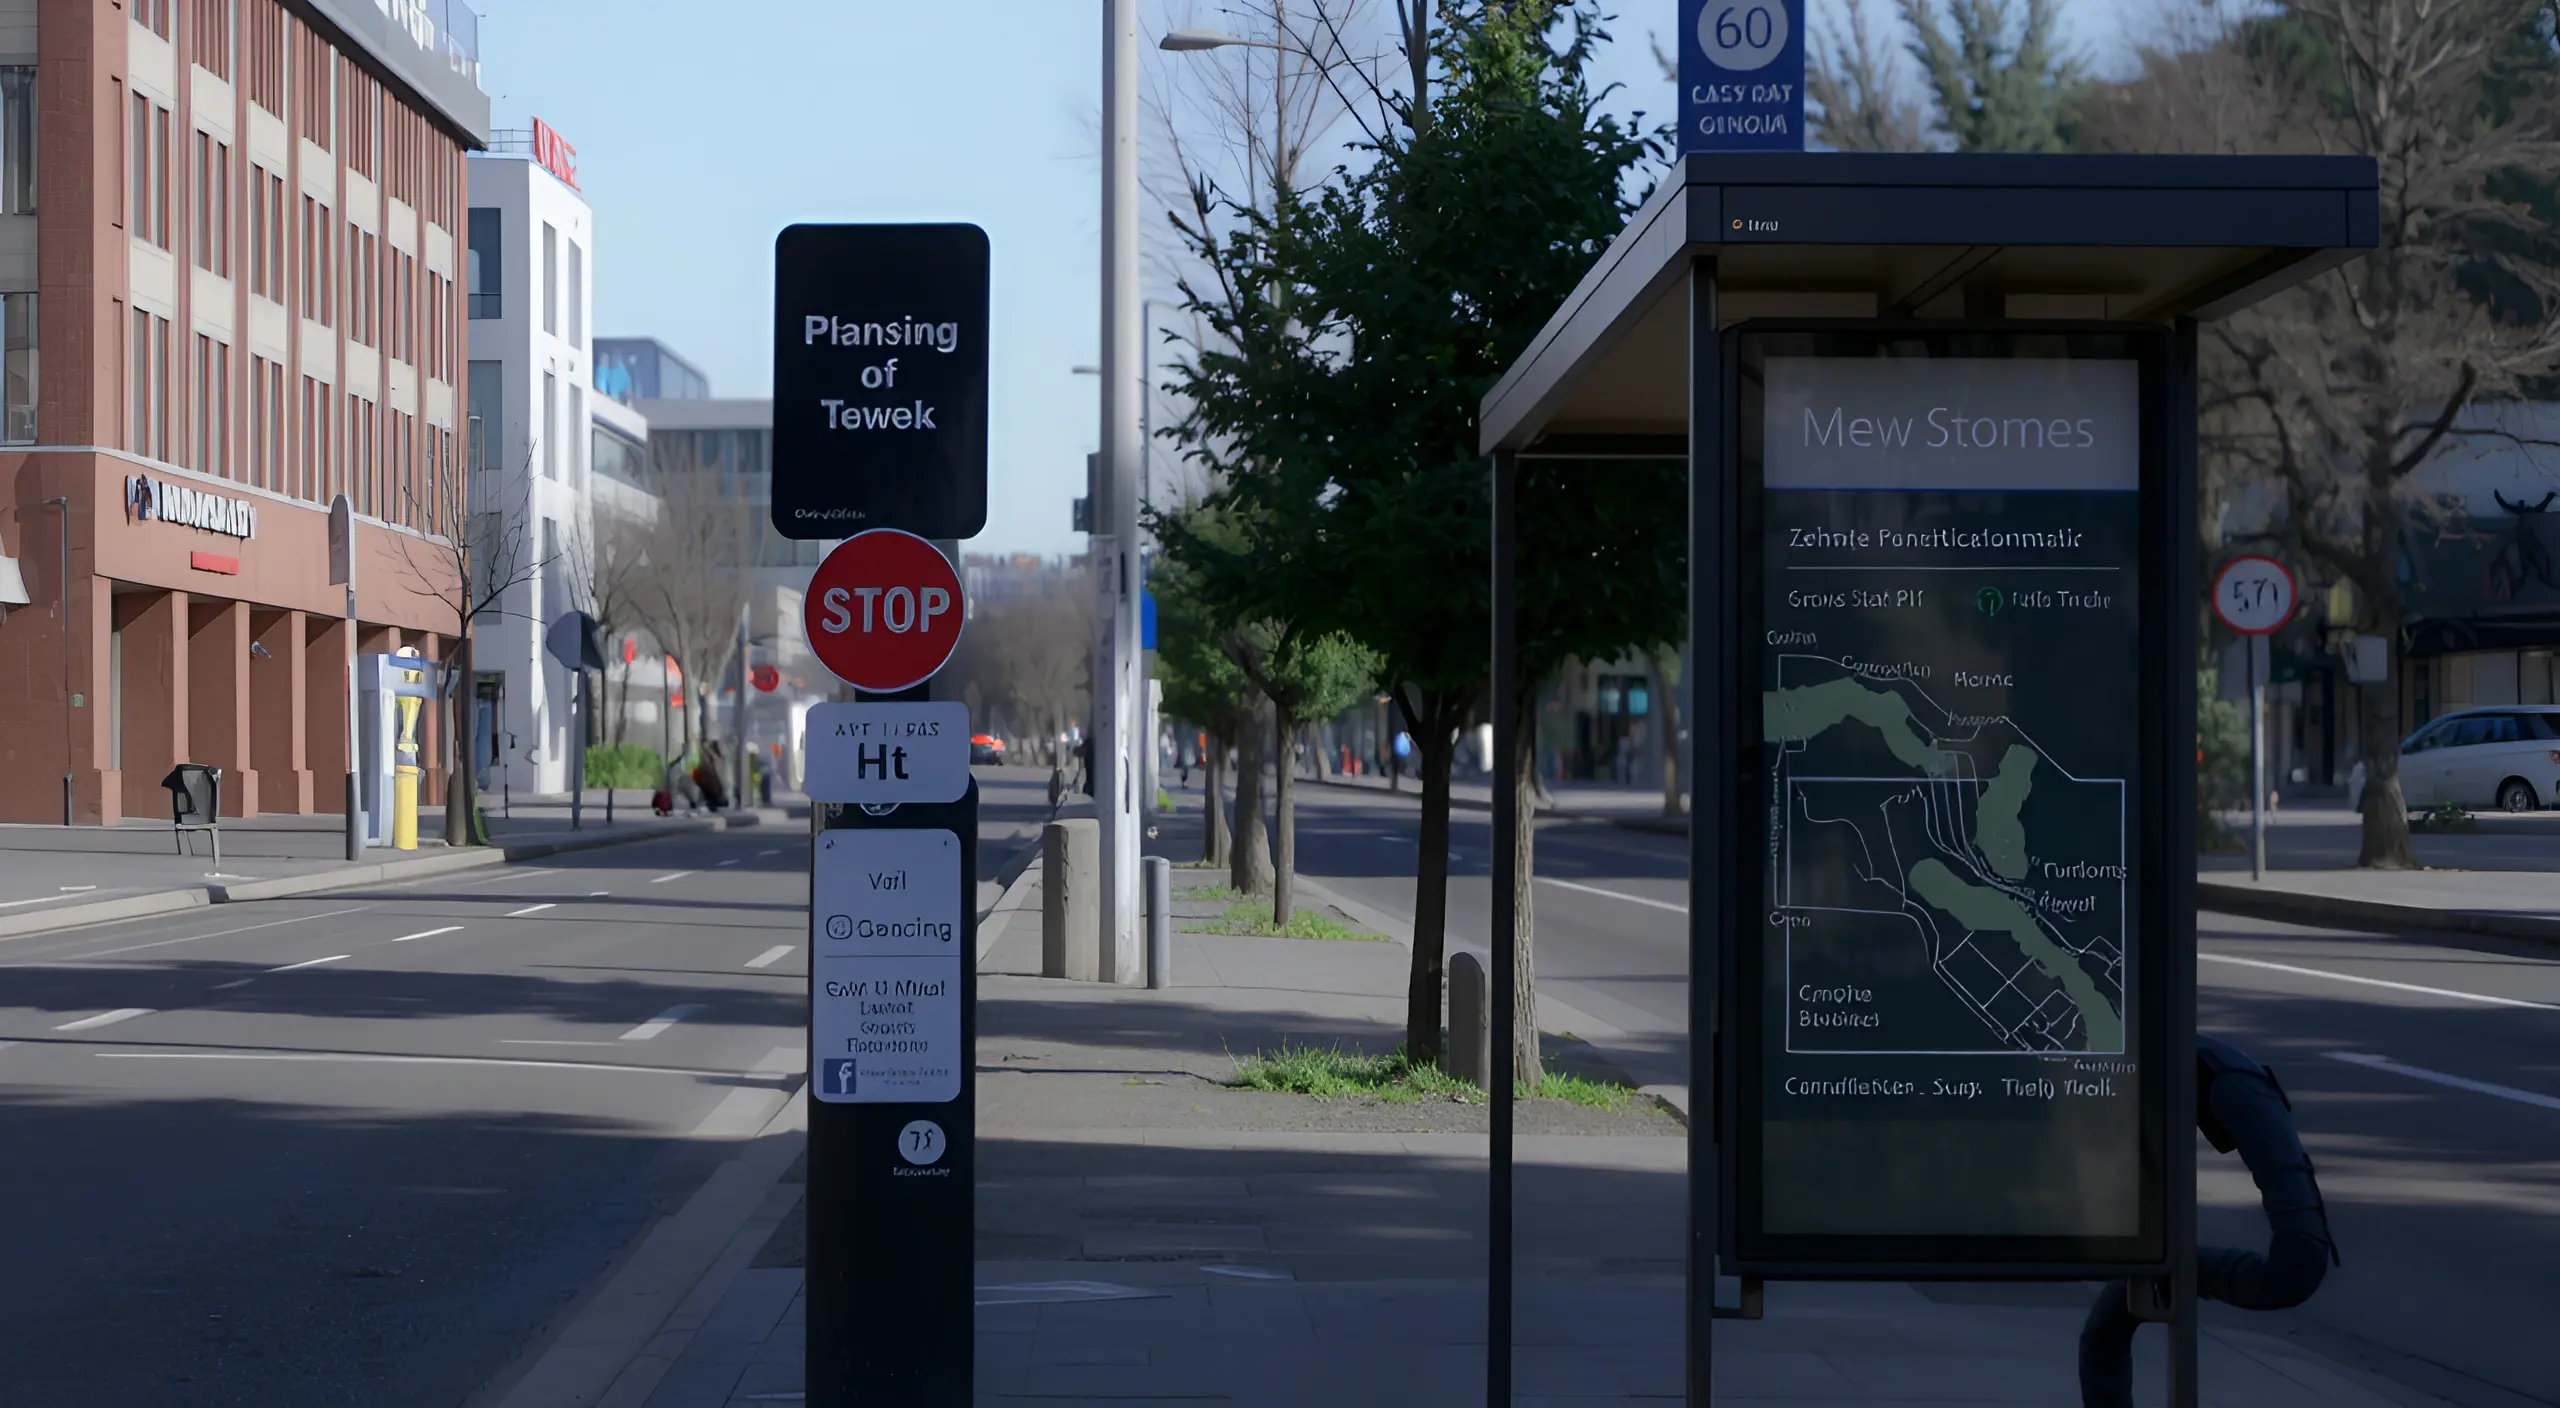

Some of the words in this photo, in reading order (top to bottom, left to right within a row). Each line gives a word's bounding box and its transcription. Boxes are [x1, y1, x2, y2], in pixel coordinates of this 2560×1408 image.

[1715, 6, 1772, 49] 60
[805, 315, 958, 353] Plansing
[861, 358, 898, 389] of
[821, 399, 937, 430] Tewek
[1803, 406, 1913, 448] Mew
[1926, 406, 2095, 448] Stomes
[822, 586, 951, 634] STOP
[857, 742, 909, 781] Ht
